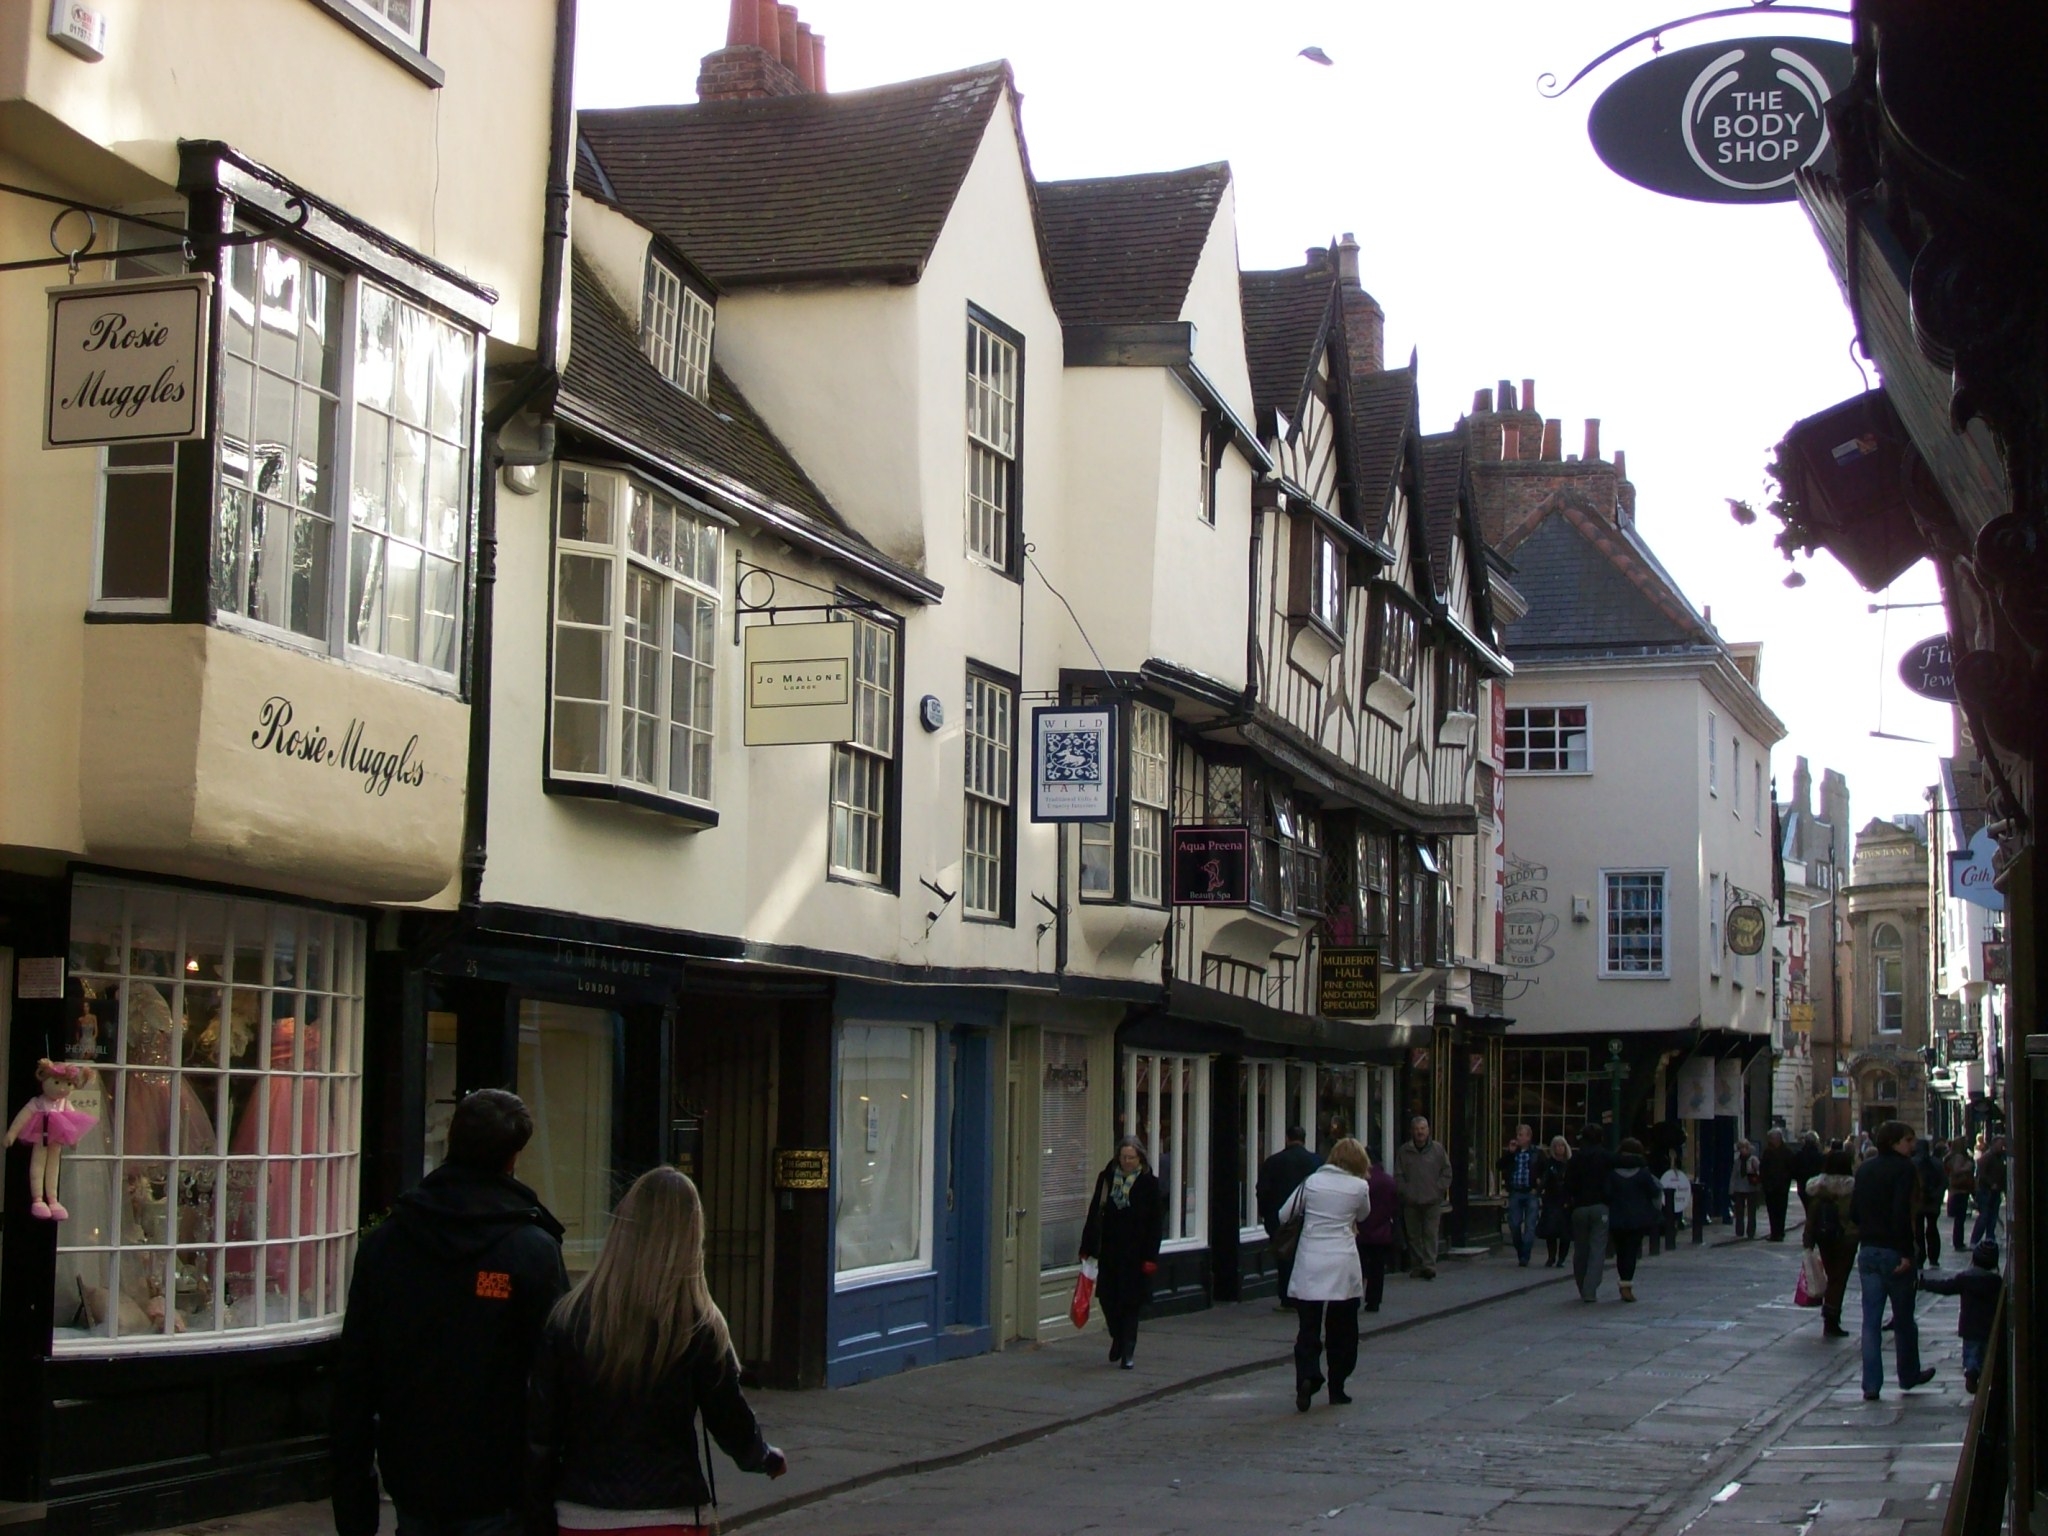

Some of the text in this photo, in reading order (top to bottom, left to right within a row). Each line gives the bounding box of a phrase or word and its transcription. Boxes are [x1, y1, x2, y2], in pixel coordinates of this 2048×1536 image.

[1731, 91, 1783, 111] THE
[1714, 113, 1805, 138] BODY
[1718, 140, 1799, 163] SHOP
[83, 313, 169, 352] Rosie
[252, 696, 327, 763] Rosie
[1044, 719, 1103, 728] WILD
[327, 718, 424, 797] Muggles
[1043, 784, 1101, 793] HART
[1179, 841, 1243, 853] Aqua Preena
[1504, 869, 1537, 886] TEDDY
[1961, 865, 1990, 886] Cath
[1190, 891, 1231, 900] Beauty Spa
[1504, 889, 1538, 905] BEAR
[1509, 925, 1534, 935] TEA
[1323, 956, 1376, 966] MULBERRY
[1511, 955, 1536, 963] YORK
[466, 959, 478, 978] 25
[1335, 968, 1363, 977] HALL
[1324, 981, 1374, 989] FINE CHINA
[1323, 1001, 1375, 1009] SPECIALISTS
